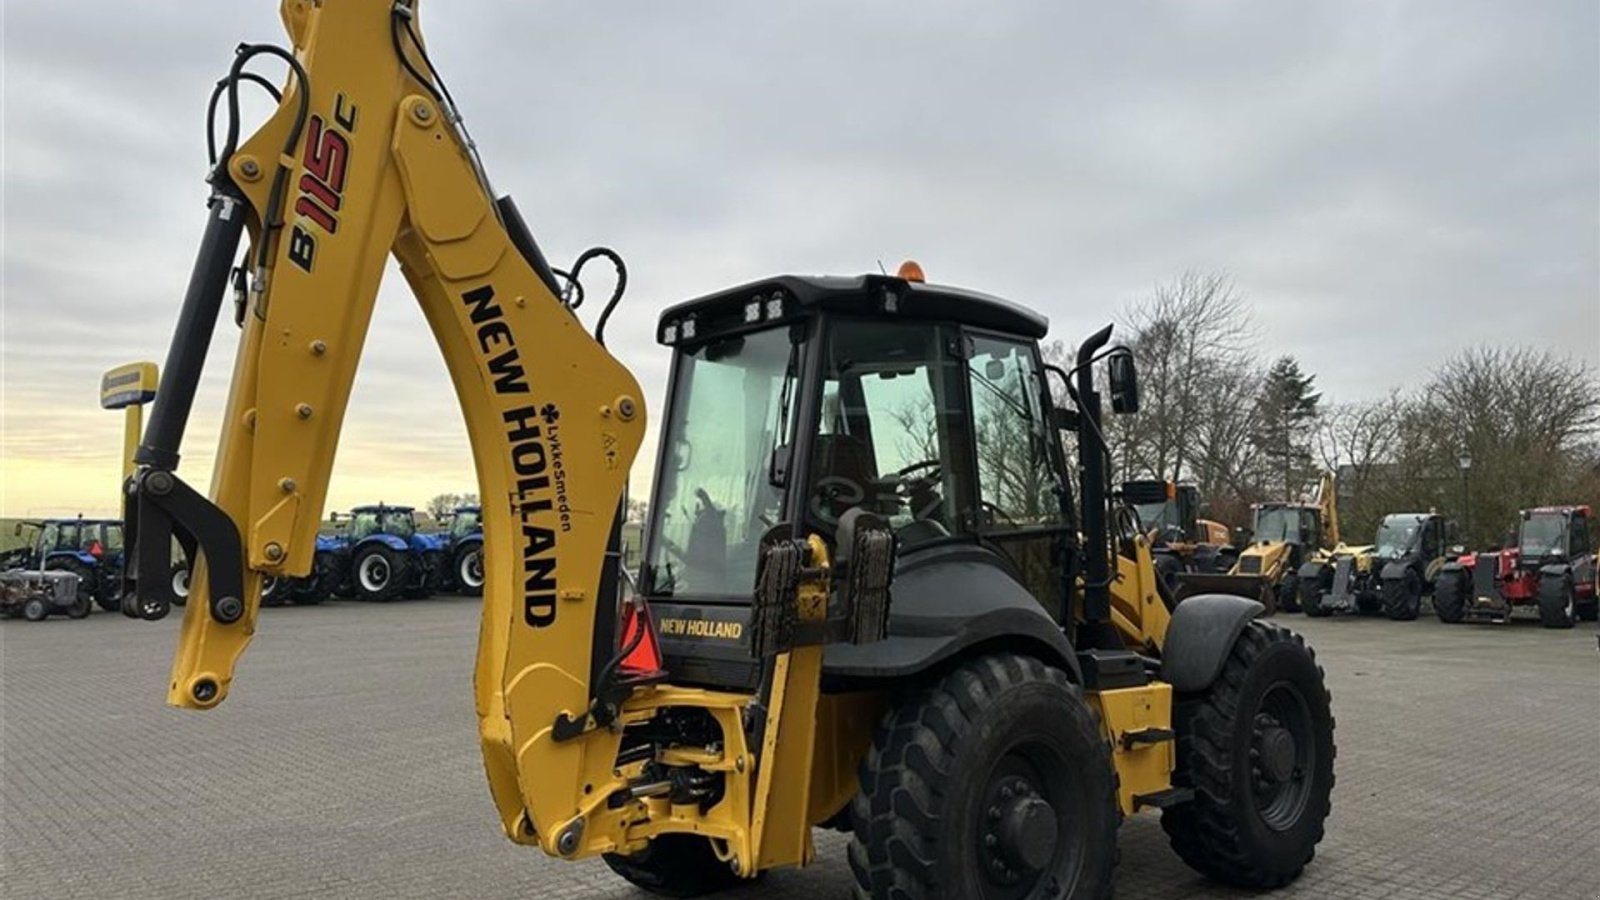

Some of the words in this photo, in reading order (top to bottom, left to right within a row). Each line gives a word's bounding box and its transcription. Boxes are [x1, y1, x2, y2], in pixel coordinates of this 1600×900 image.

[461, 285, 530, 394] NEW
[502, 405, 557, 629] HOLLAND
[547, 426, 571, 532] LykkeSmeden
[660, 619, 686, 634] NEW
[687, 620, 743, 639] HOLLAND
